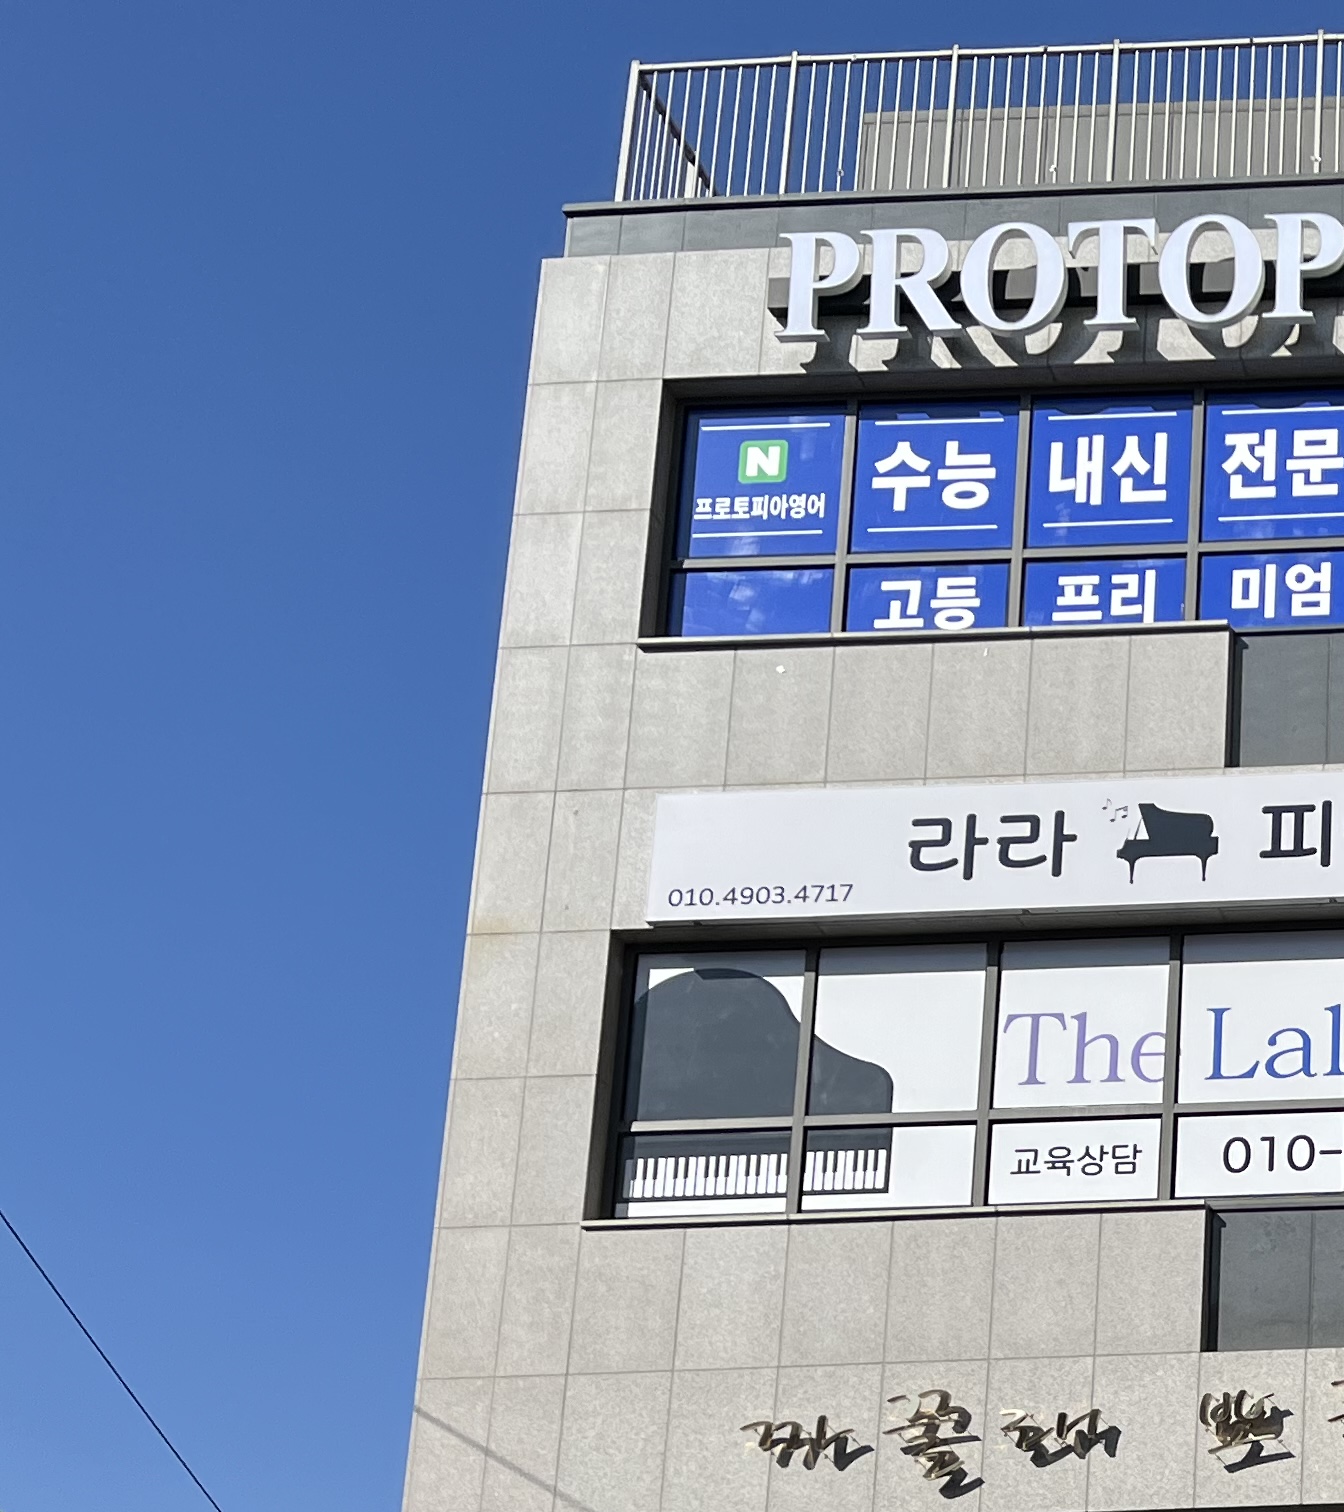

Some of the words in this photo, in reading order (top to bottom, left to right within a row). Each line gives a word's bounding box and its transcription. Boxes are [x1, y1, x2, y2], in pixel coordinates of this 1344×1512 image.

[693, 492, 826, 521] 프로토피아영어
[871, 440, 997, 512] 수능
[1048, 432, 1168, 506] 내신
[873, 575, 981, 632] 고등
[1051, 568, 1158, 624] 프리
[1230, 561, 1333, 619] 미엄
[908, 810, 1078, 880] 라라
[667, 883, 854, 908] 010.4903.4717
[1003, 1011, 1180, 1088] The
[1009, 1142, 1143, 1177] 교육상담
